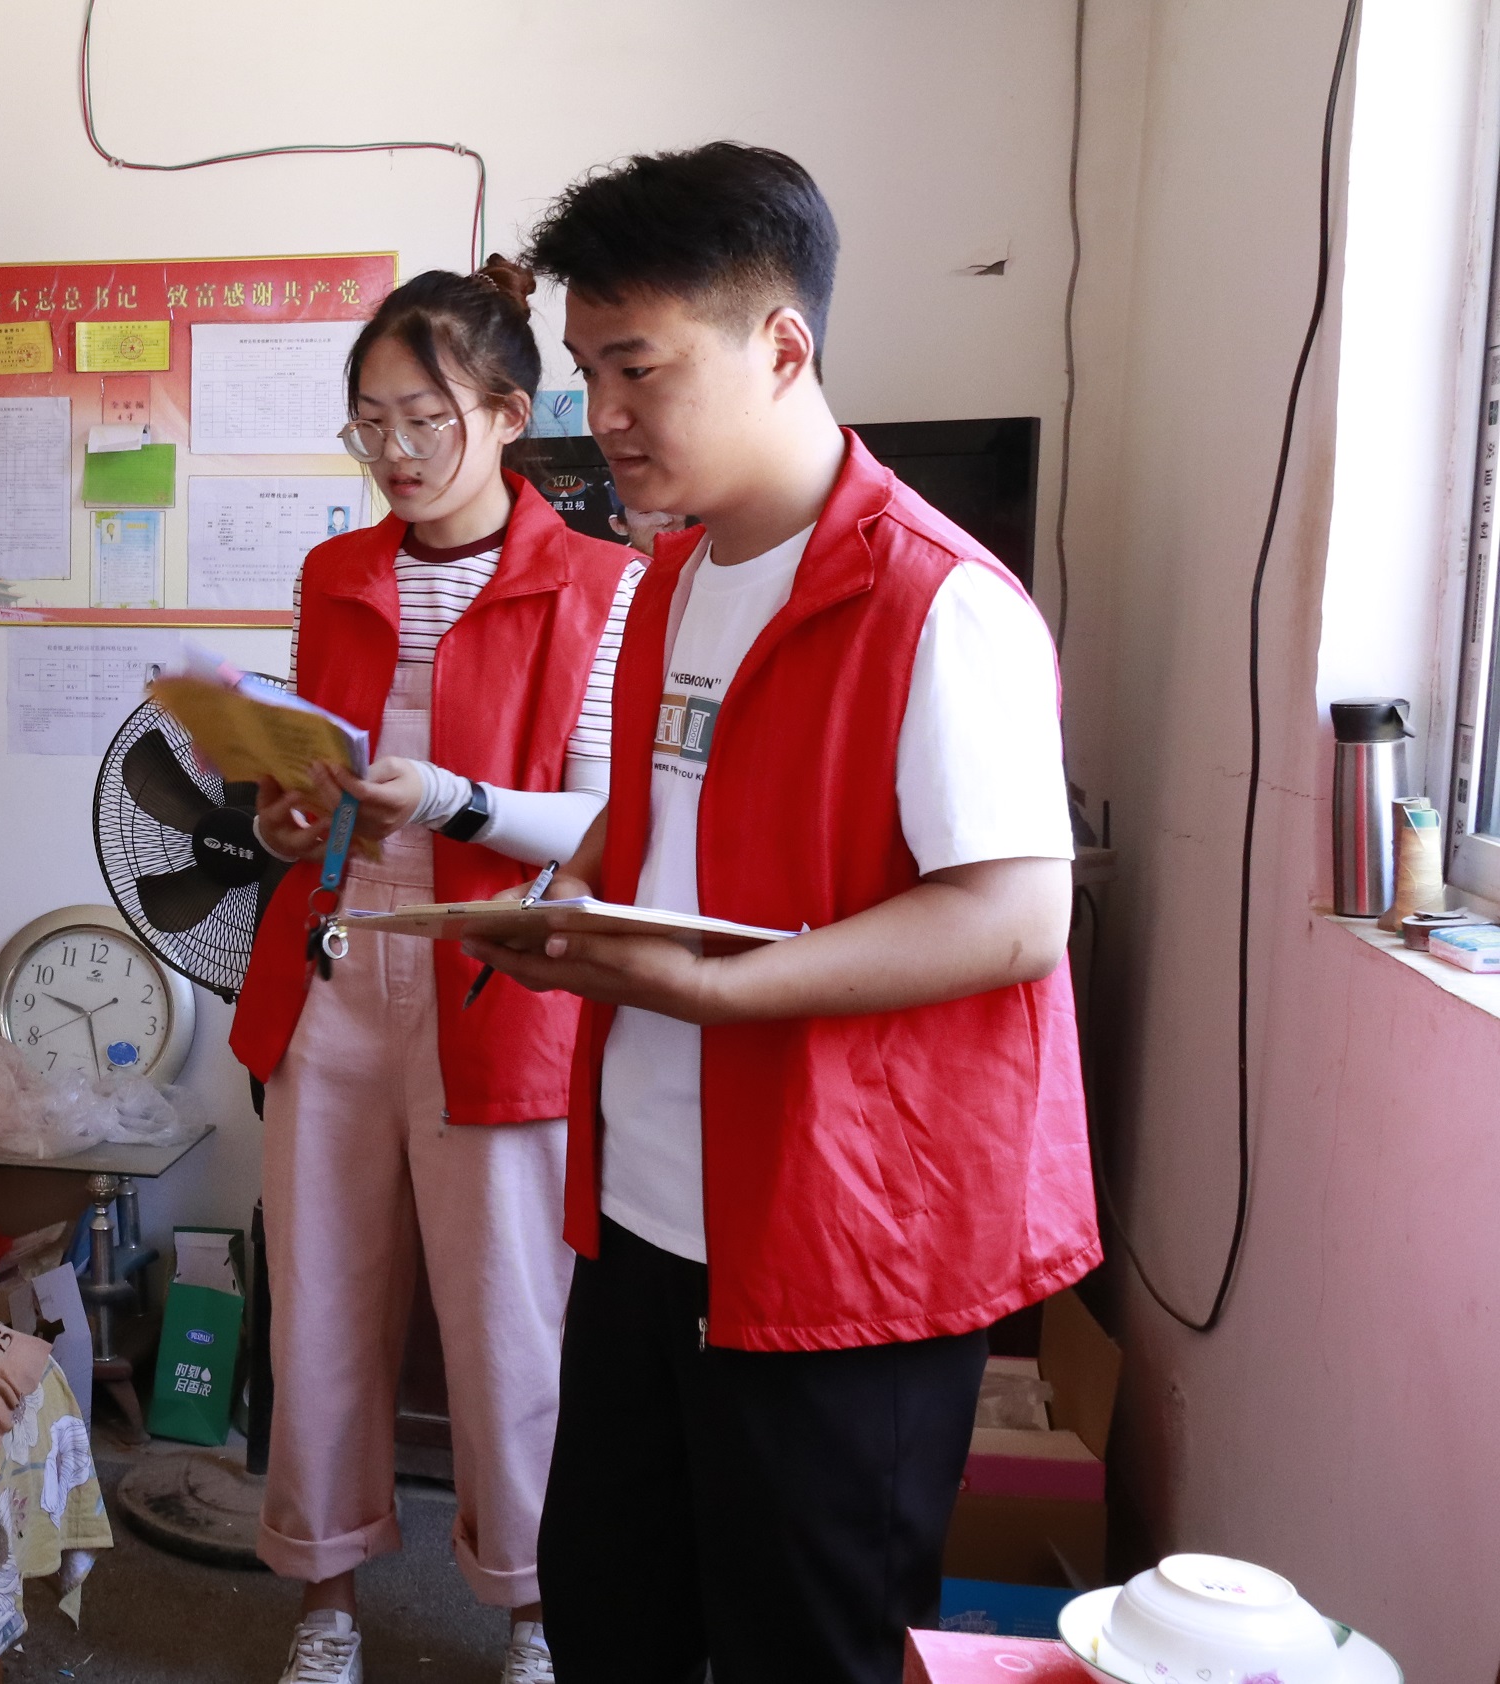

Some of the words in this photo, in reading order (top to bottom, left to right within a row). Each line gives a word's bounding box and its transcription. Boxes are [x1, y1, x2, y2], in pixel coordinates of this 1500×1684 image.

[167, 279, 360, 307] 致富感谢共产党
[112, 400, 145, 409] 全家福
[553, 474, 577, 488] XZTV
[548, 500, 586, 511] 藏卫视
[654, 763, 669, 772] WERE
[222, 842, 254, 860] 先锋
[61, 946, 77, 968] 11
[90, 942, 109, 965] 12
[34, 964, 54, 986] 10
[125, 957, 132, 977] 1
[23, 993, 36, 1013] 9
[141, 984, 154, 1005] 2
[27, 1025, 40, 1046] 8
[145, 1015, 157, 1036] 3
[46, 1051, 58, 1071] 7
[174, 1362, 201, 1379] 时刻
